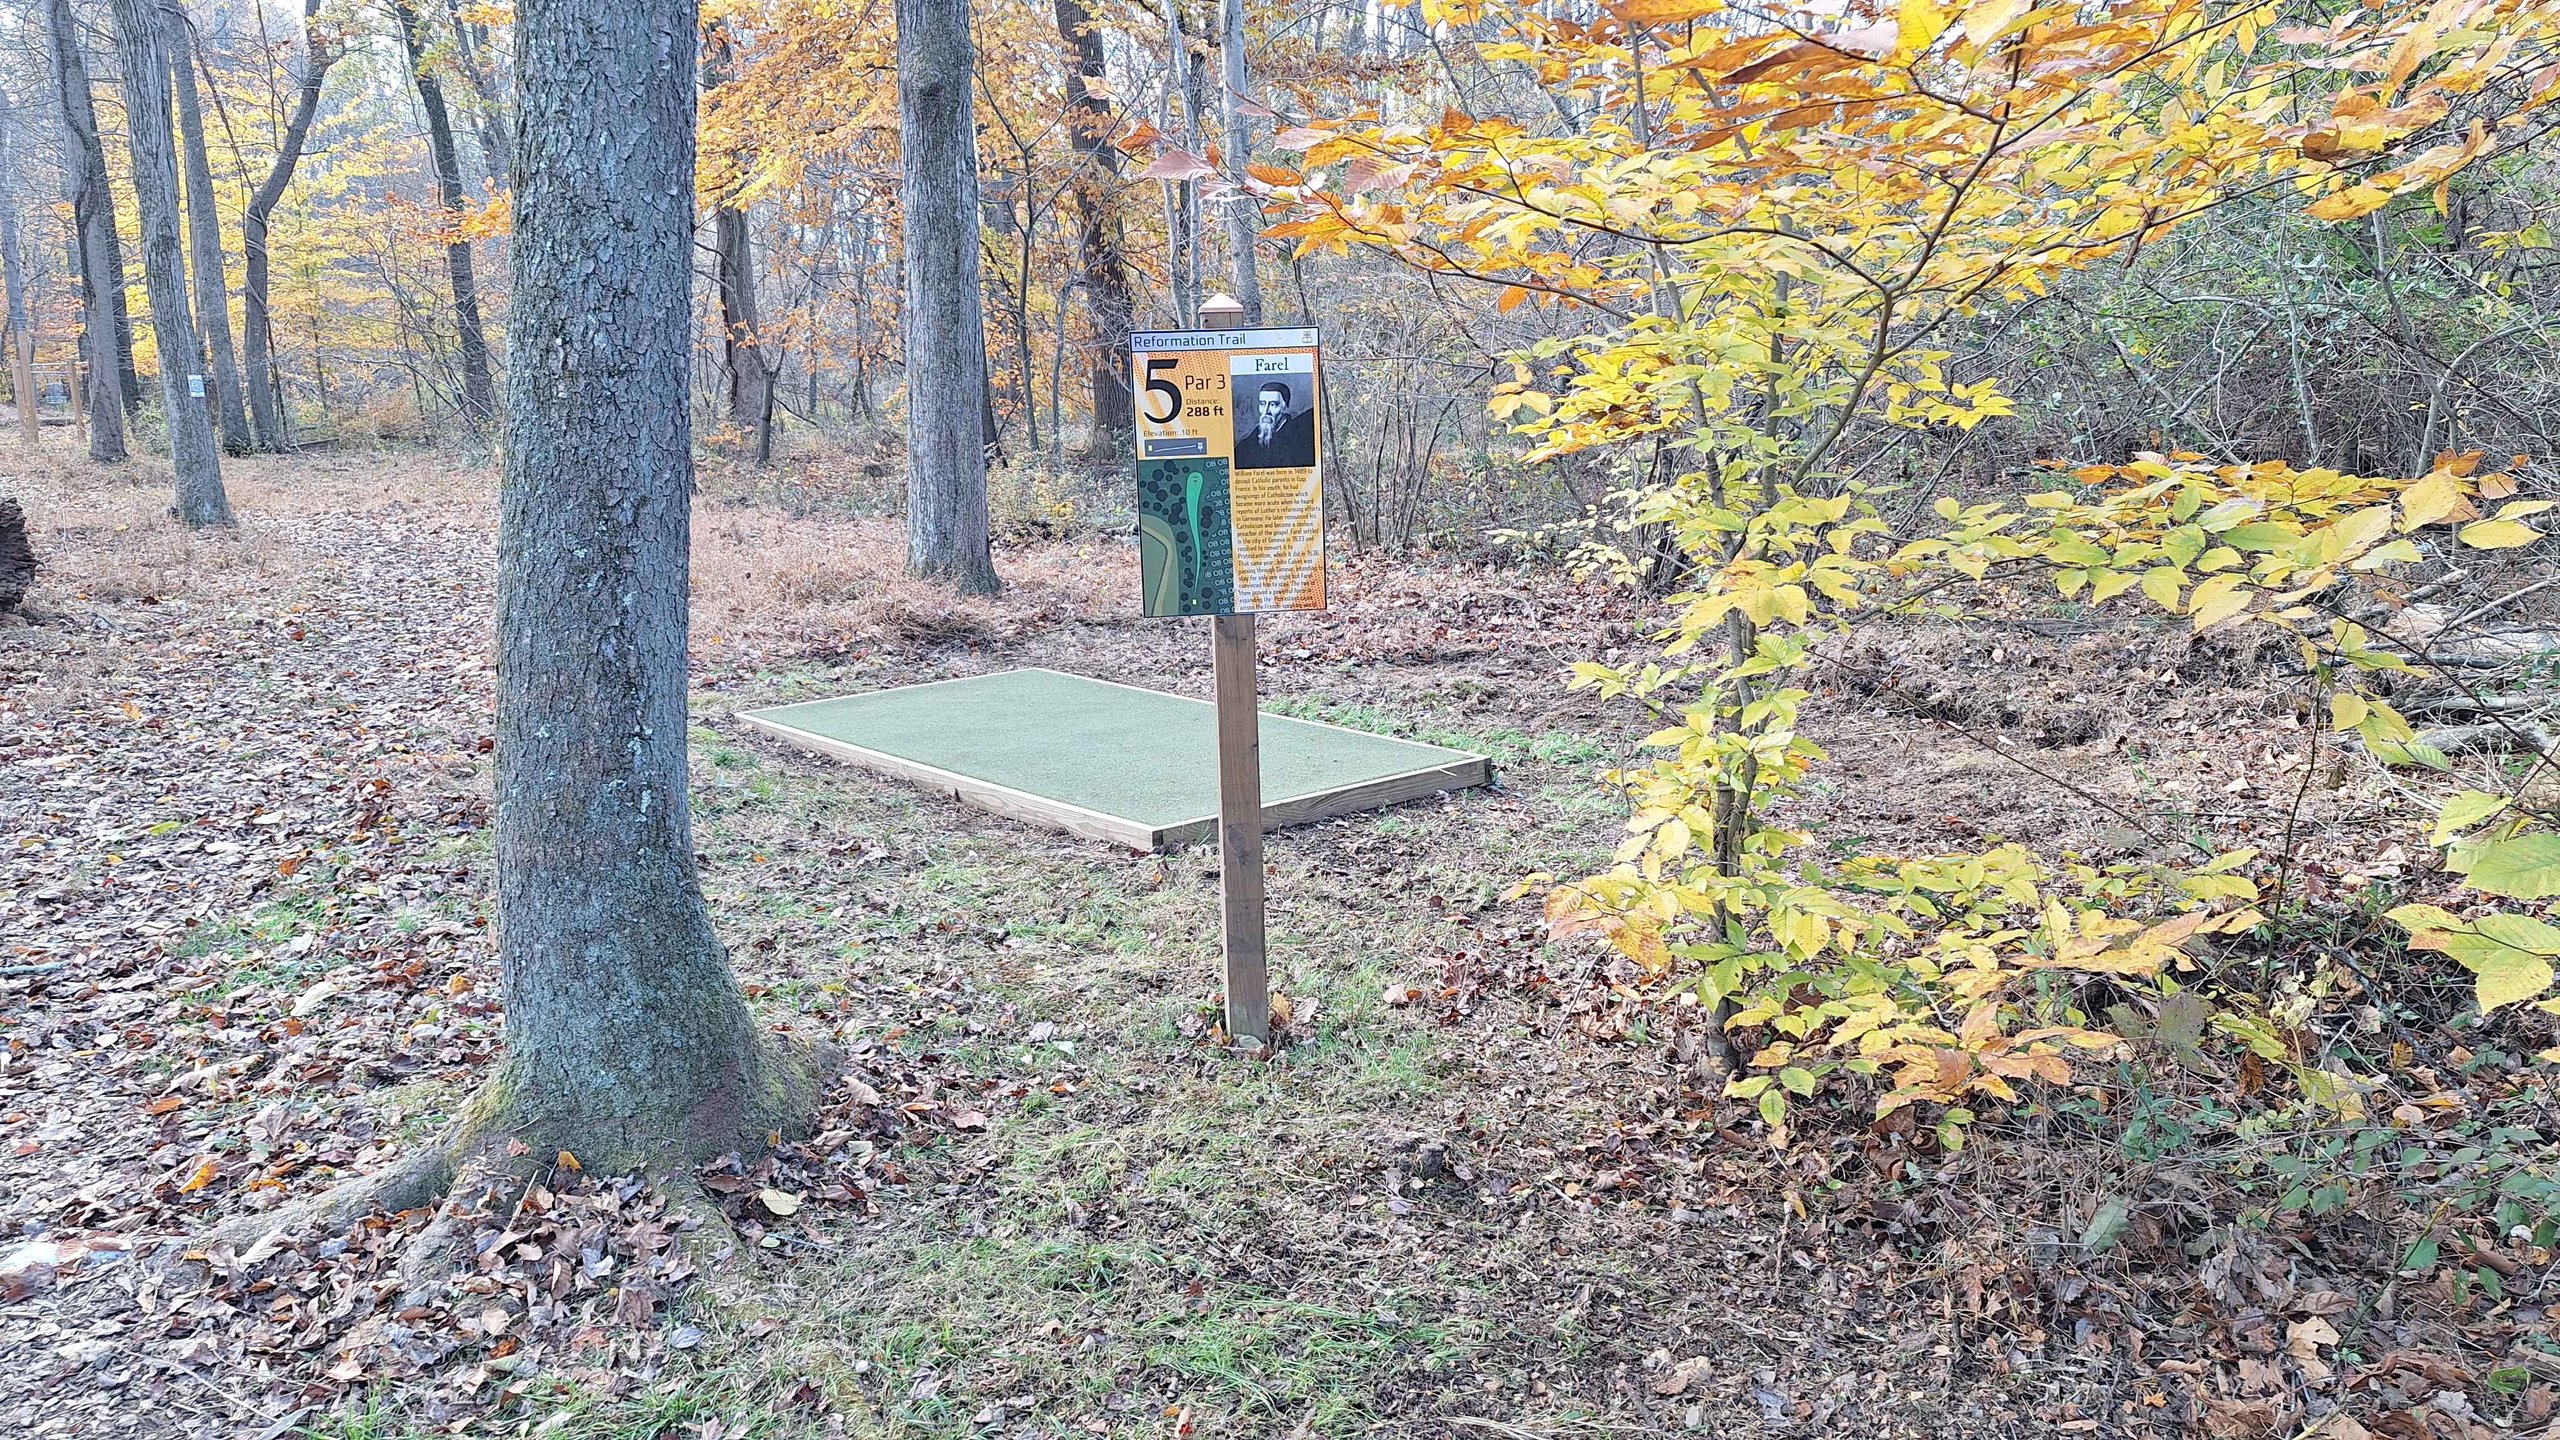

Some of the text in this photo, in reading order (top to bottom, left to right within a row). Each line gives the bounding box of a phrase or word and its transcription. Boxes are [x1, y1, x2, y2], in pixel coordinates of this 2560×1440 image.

[1134, 333, 1246, 348] Reformation Trail
[1255, 357, 1289, 372] Farel
[1185, 374, 1226, 390] Par 3
[1143, 358, 1182, 424] 5
[1187, 405, 1224, 417] 288 ft
[1143, 429, 1179, 437] Elevation:
[1192, 428, 1198, 436] ft
[1205, 458, 1228, 468] OB OB
[1208, 540, 1219, 548] OB
[1210, 548, 1231, 558] OB OB
[1213, 569, 1224, 577] OB
[1214, 578, 1225, 586] OB
